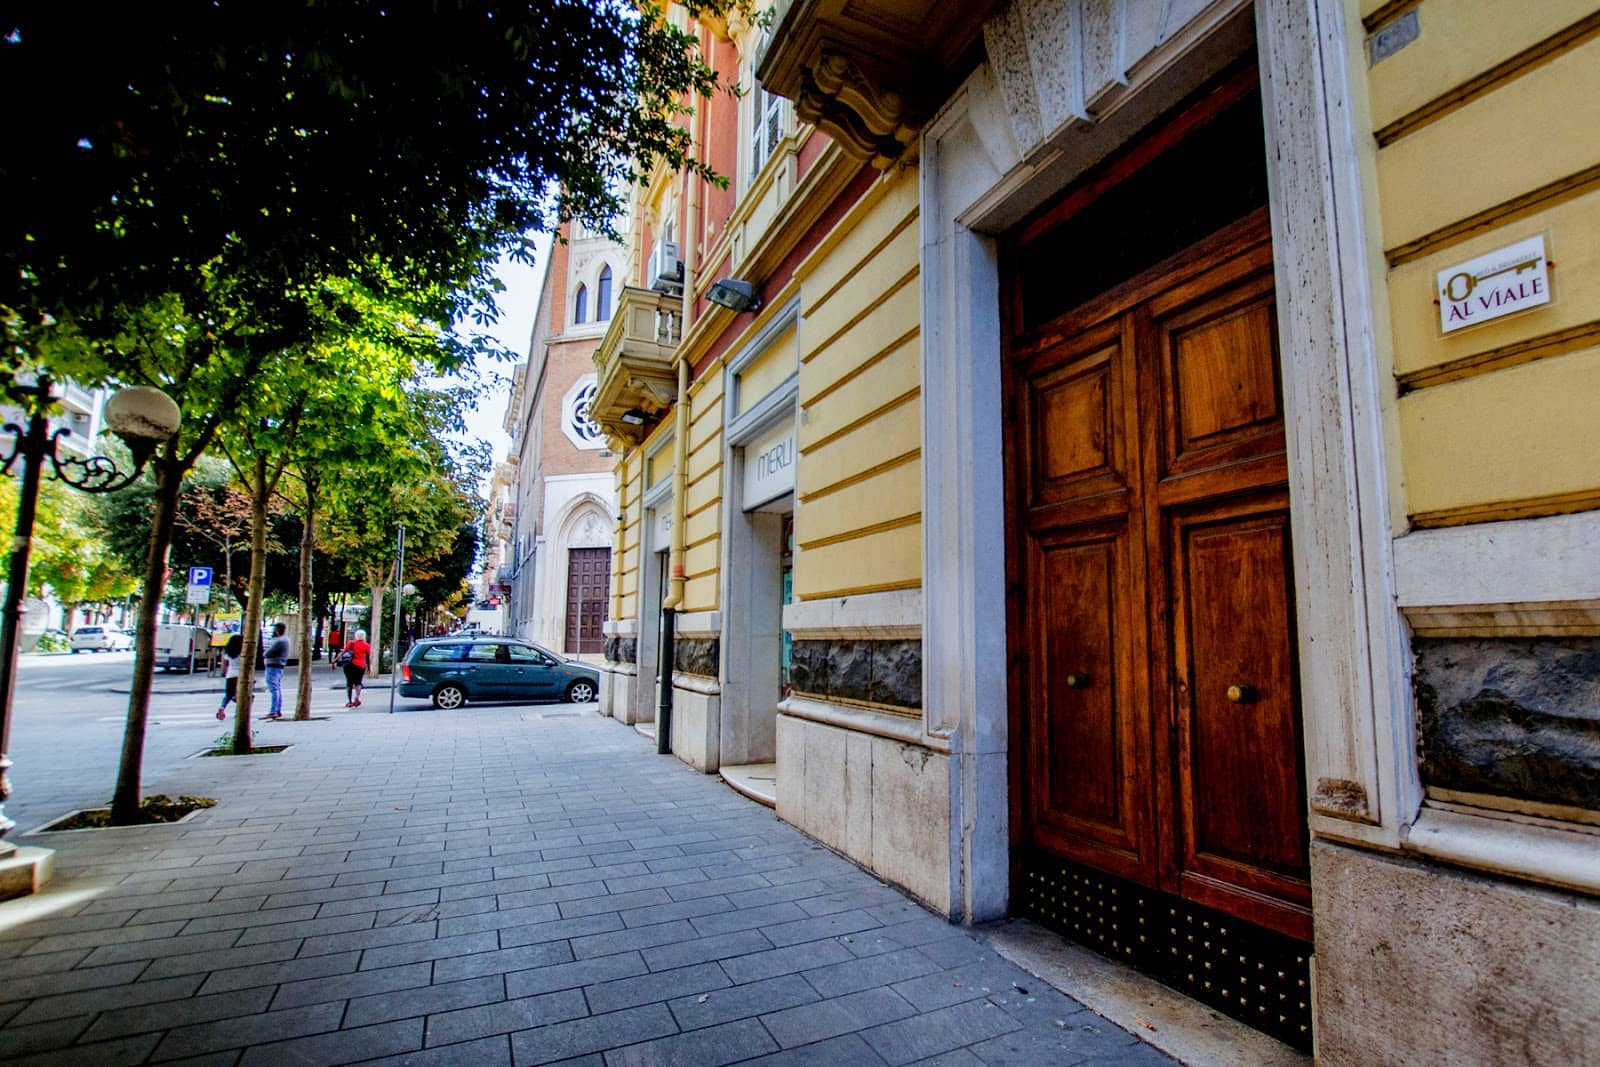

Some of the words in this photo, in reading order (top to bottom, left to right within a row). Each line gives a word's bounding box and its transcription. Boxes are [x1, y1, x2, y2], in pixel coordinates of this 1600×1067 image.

[1449, 301, 1474, 321] AL
[1479, 276, 1544, 310] VIALE
[193, 569, 207, 584] P
